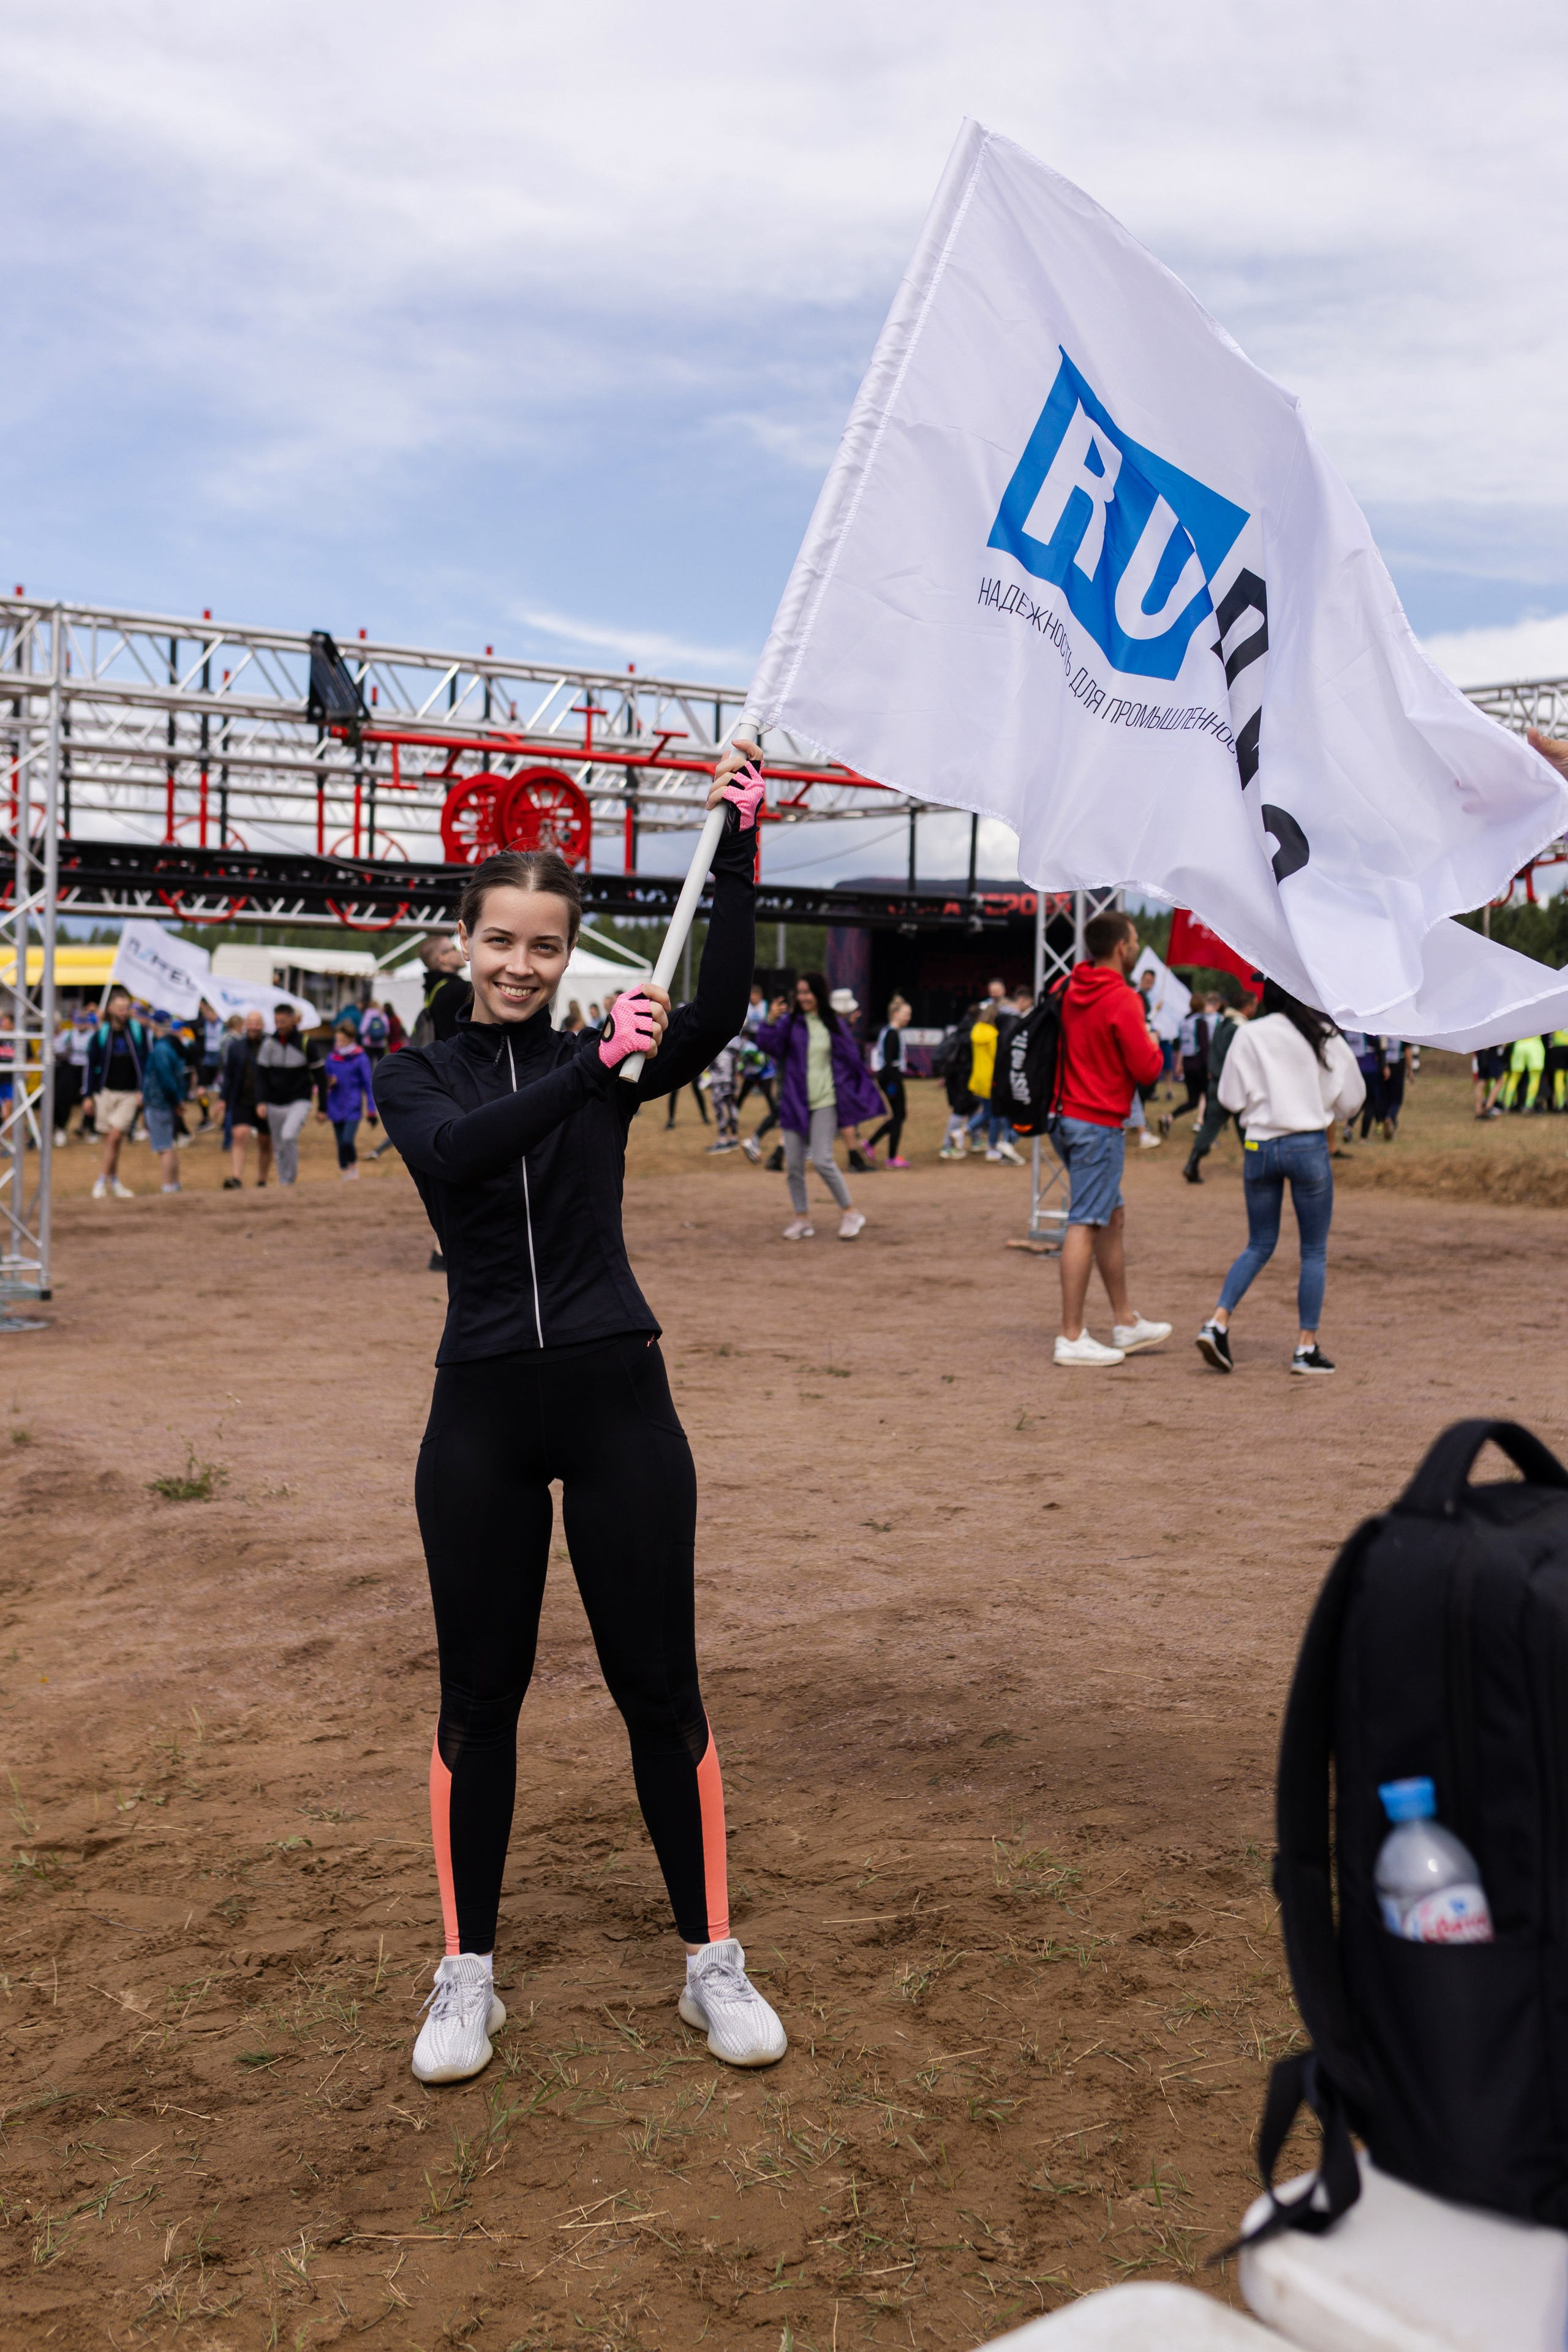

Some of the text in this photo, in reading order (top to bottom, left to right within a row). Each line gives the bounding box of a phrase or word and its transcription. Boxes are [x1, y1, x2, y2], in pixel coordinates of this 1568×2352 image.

[978, 577, 1238, 763] НАДЕЖНОСТЬ ДЛЯ ПРОМЫШЛЕННОС
[1009, 1070, 1032, 1106] JUST
